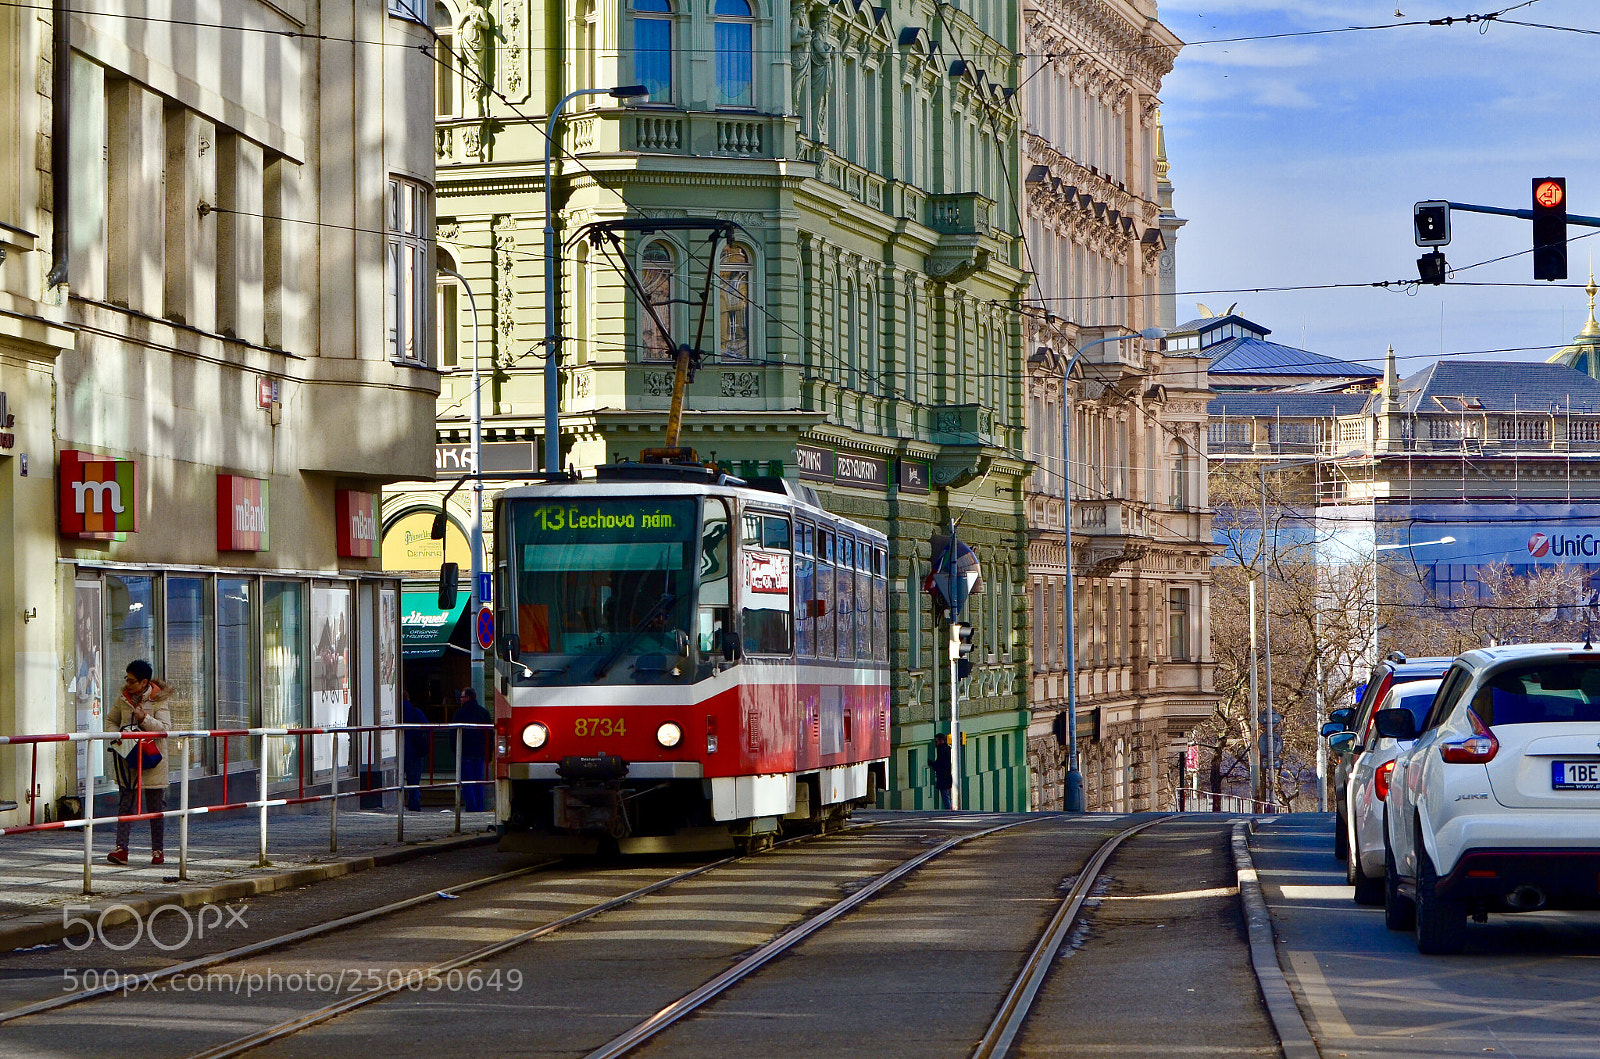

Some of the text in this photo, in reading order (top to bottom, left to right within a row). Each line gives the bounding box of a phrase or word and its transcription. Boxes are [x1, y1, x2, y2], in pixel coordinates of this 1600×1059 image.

[71, 480, 125, 514] m
[235, 497, 266, 532] mBank
[352, 509, 377, 541] mBank
[534, 505, 566, 530] 13
[1552, 534, 1600, 556] UniCr
[574, 717, 627, 737] 8734
[1568, 765, 1599, 781] 1BE
[1454, 792, 1488, 801] JUKE
